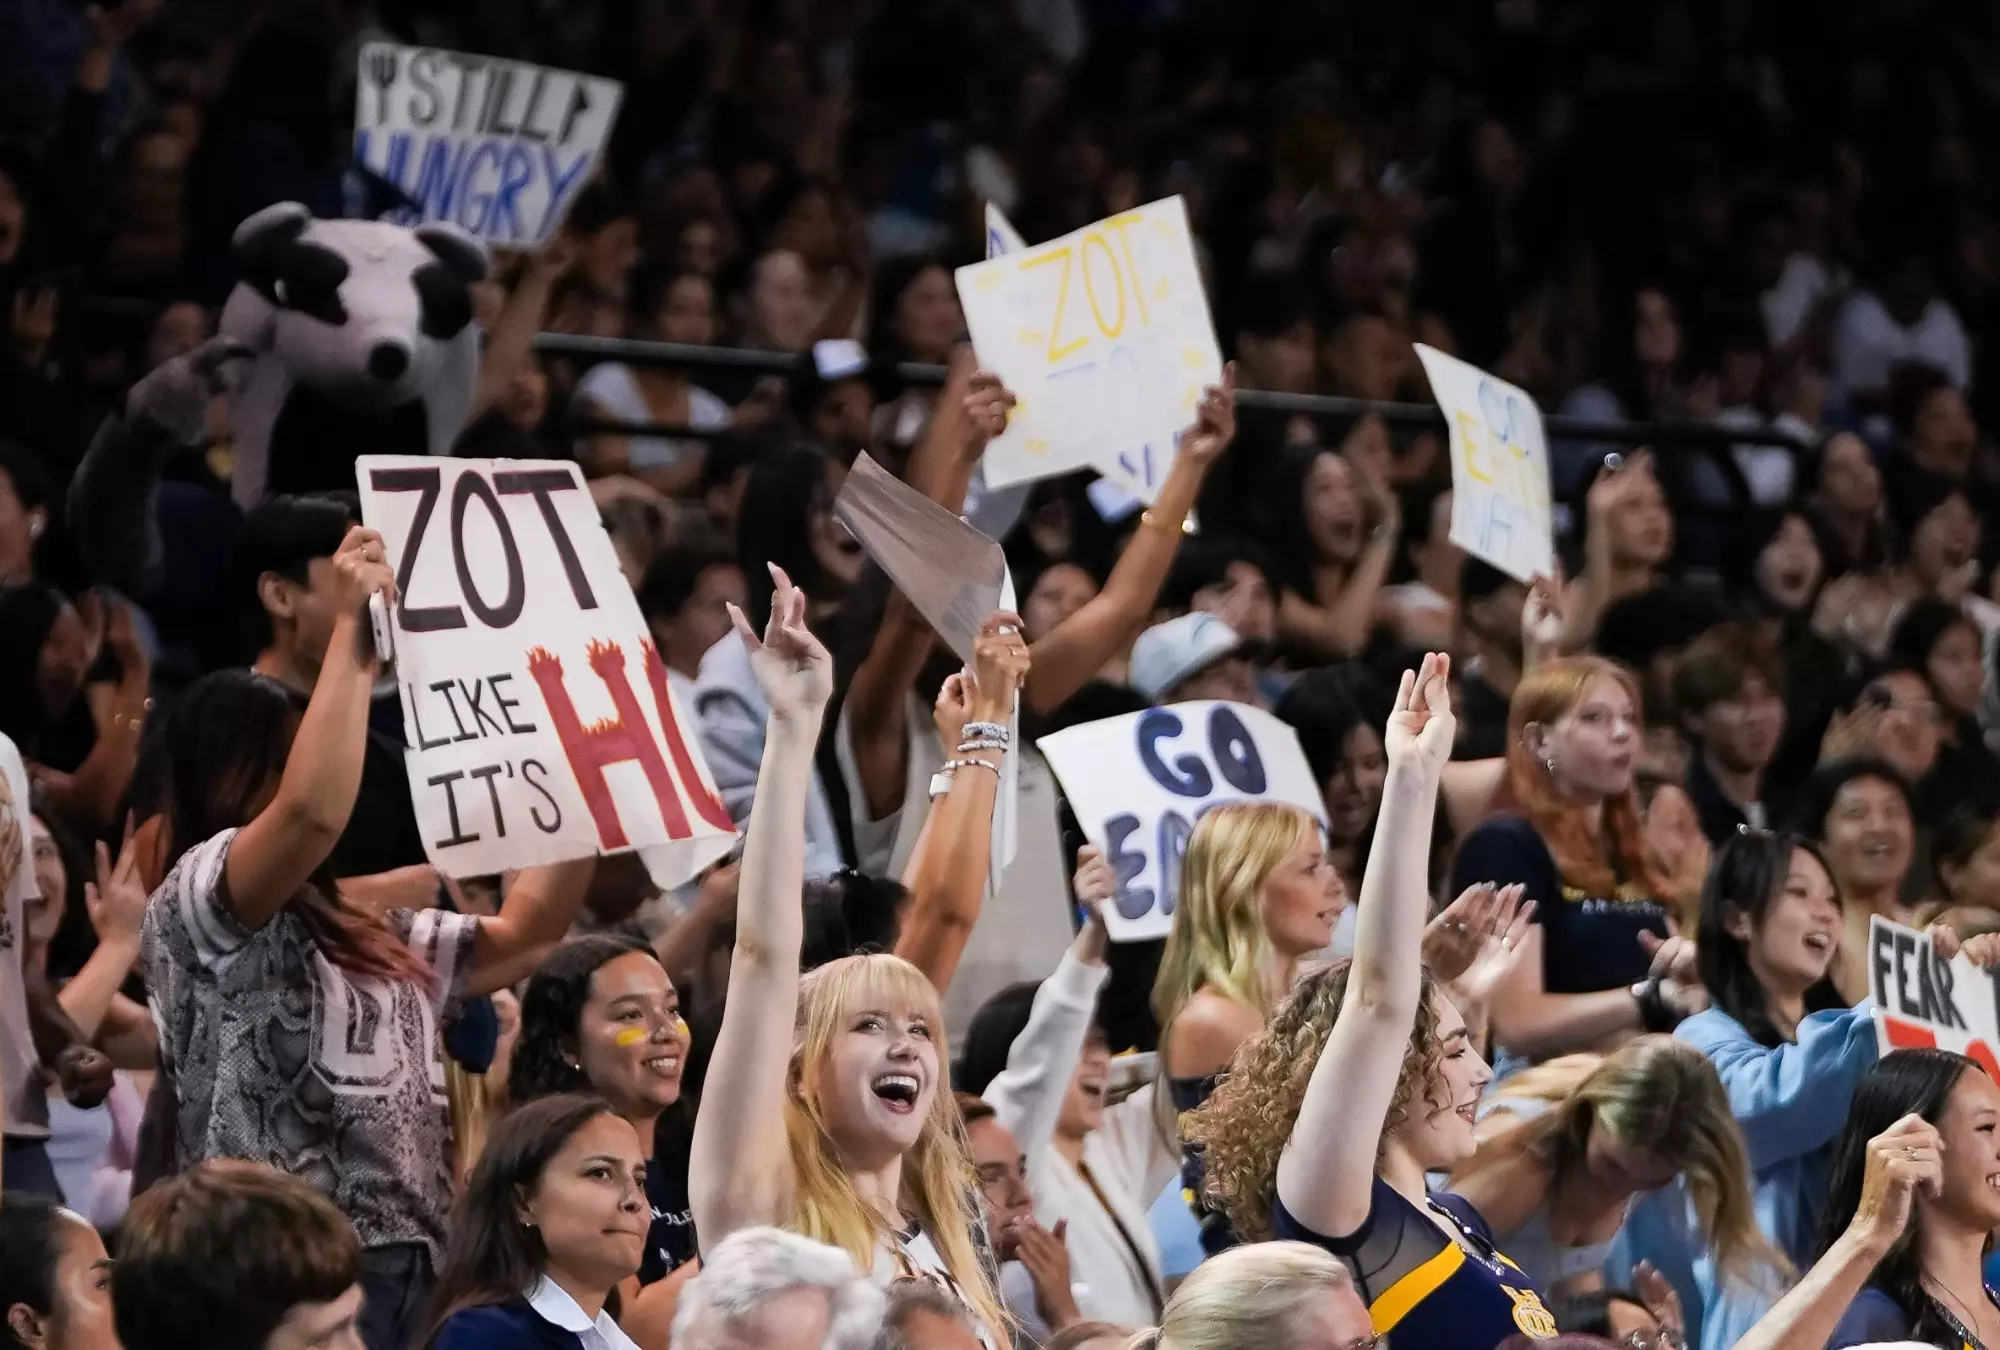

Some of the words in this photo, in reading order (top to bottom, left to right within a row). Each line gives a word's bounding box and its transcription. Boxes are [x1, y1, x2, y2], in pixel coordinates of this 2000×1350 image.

[407, 52, 548, 139] STILL
[1019, 213, 1148, 363] ZOT
[369, 466, 599, 632] ZOT
[408, 672, 537, 752] LIKE
[1135, 702, 1267, 798] GO
[427, 758, 562, 850] IT'S
[1873, 923, 1969, 1032] FEAR
